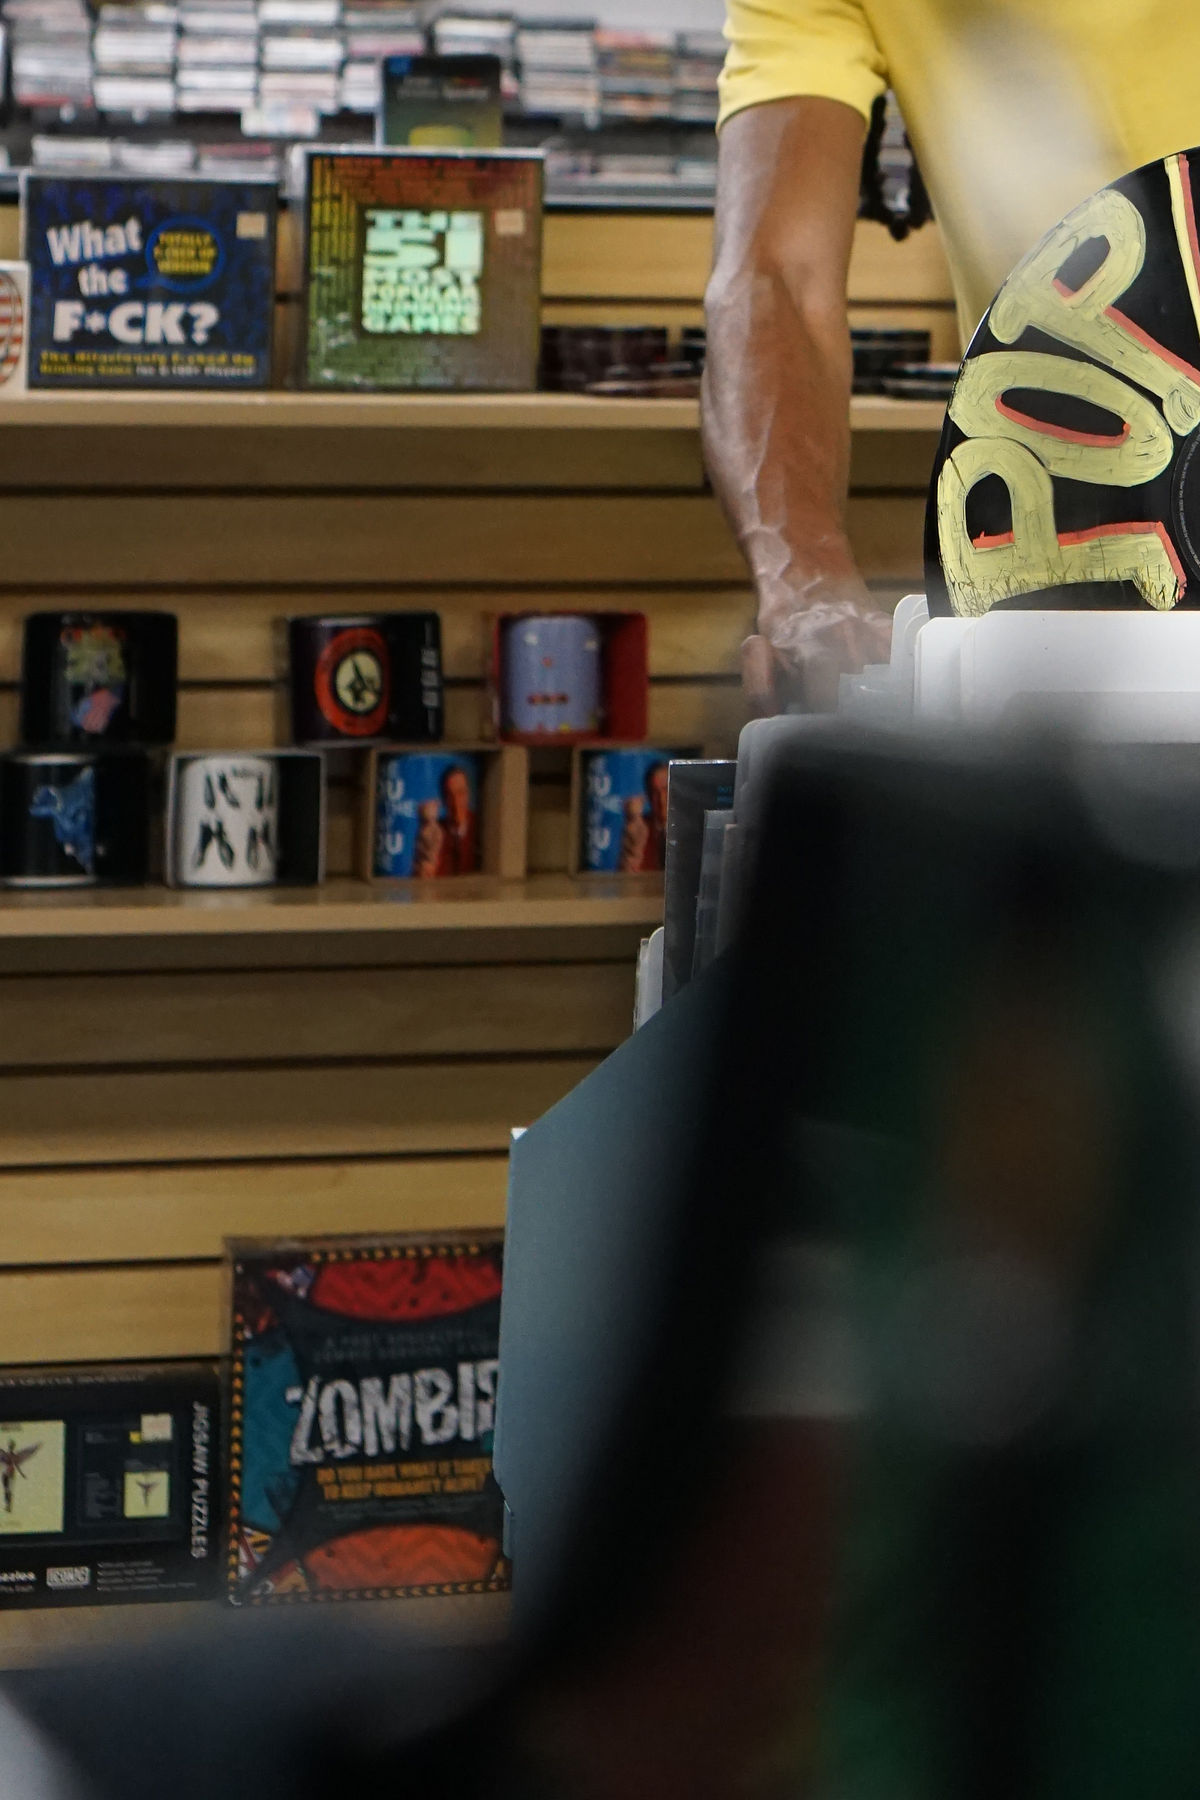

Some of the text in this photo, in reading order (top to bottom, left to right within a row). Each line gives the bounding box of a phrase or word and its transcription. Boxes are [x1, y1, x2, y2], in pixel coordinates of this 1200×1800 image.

[46, 216, 141, 265] What
[78, 263, 127, 296] the
[190, 1478, 210, 1558] PUZZLES
